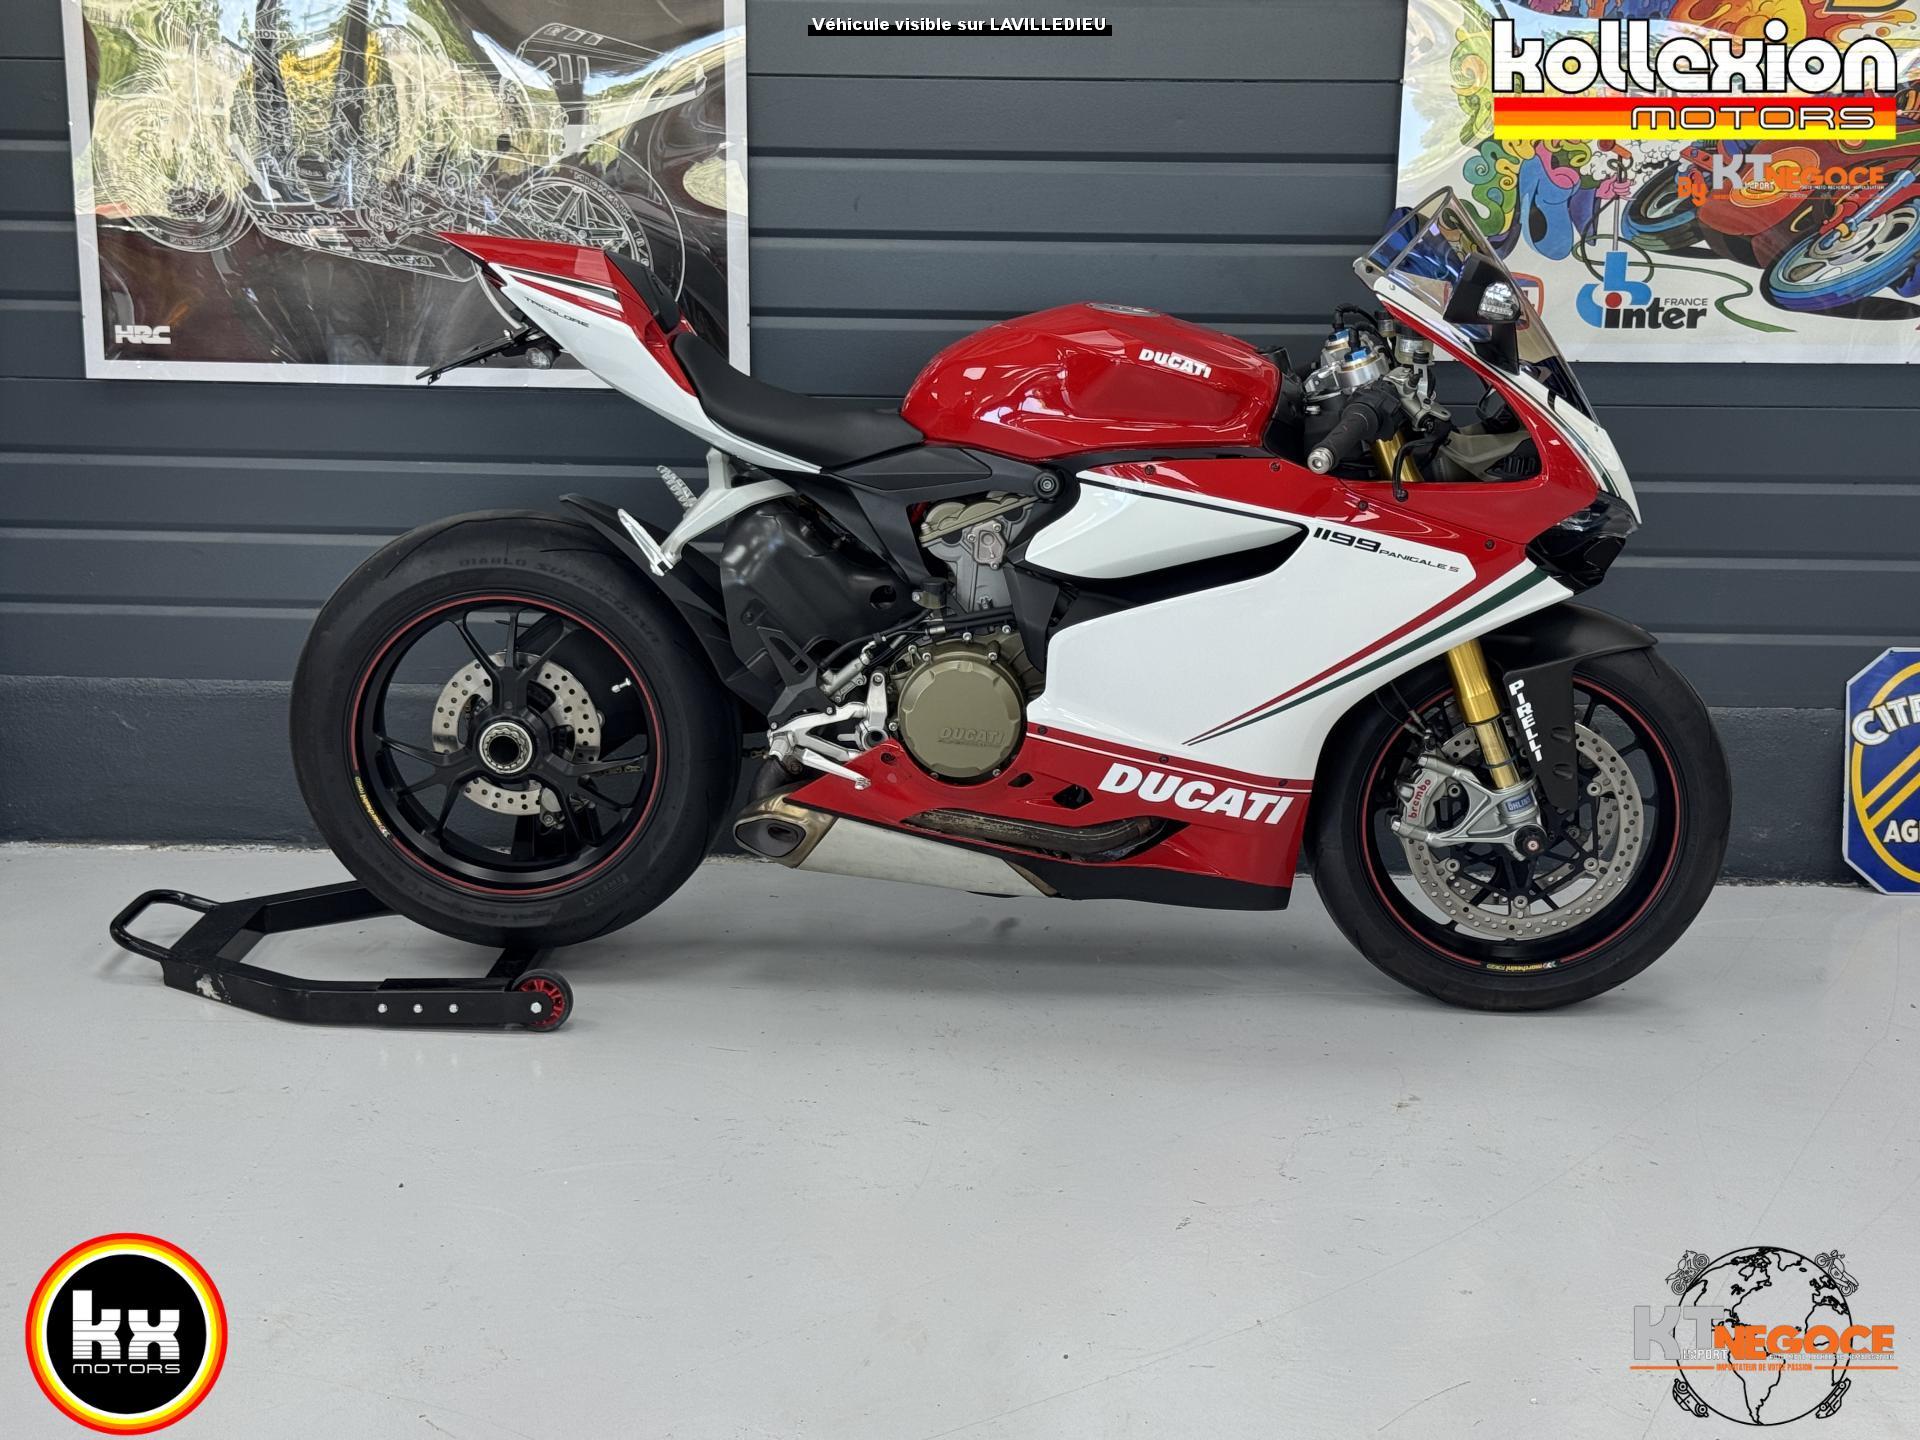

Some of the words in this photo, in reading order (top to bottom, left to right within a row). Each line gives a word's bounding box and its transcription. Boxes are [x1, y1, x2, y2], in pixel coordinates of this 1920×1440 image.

[255, 211, 359, 228] HONDA
[523, 297, 591, 328] TRICOLORE
[1604, 292, 1707, 329] inter
[1664, 298, 1708, 306] FRANCE
[114, 324, 172, 345] HRC
[1138, 348, 1212, 379] DUCATI
[458, 556, 527, 568] DIABLO
[1313, 527, 1382, 553] 1199
[1379, 549, 1448, 570] PANIGALE
[940, 726, 1008, 746] DUCATI
[1508, 679, 1543, 762] PIRELLI
[1097, 762, 1294, 825] DUCATI
[1408, 778, 1432, 819] brembo
[1883, 819, 1920, 843] AG
